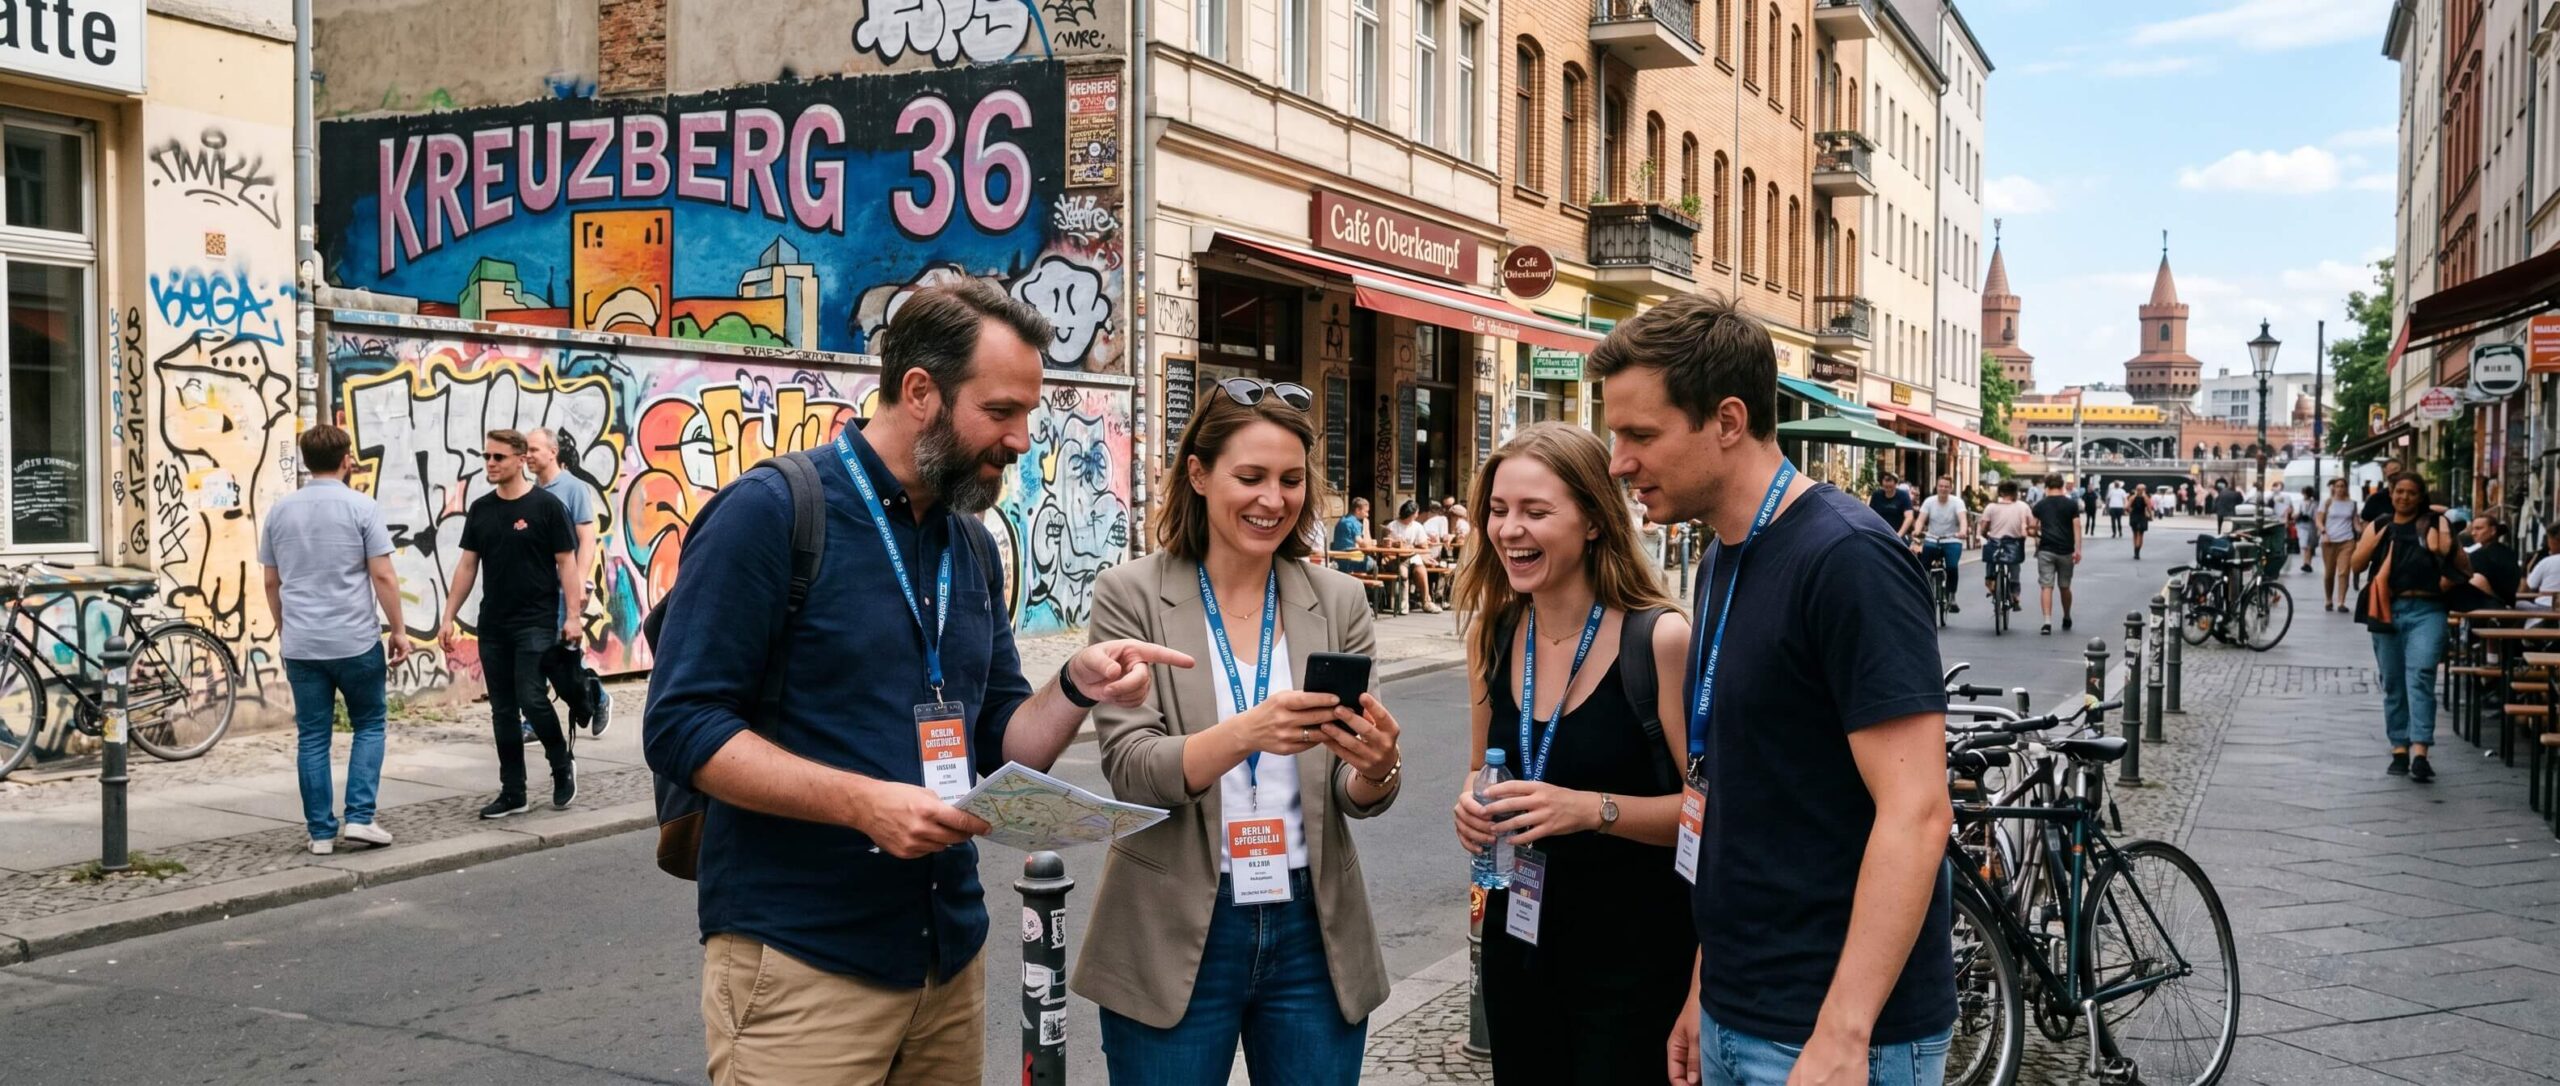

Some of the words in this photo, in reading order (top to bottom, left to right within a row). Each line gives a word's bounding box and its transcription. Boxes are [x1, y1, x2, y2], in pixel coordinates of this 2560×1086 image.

[378, 103, 846, 277] KREUZBERG
[894, 90, 1033, 237] 36
[1331, 204, 1371, 247] Café
[1375, 216, 1460, 275] Oberkampf
